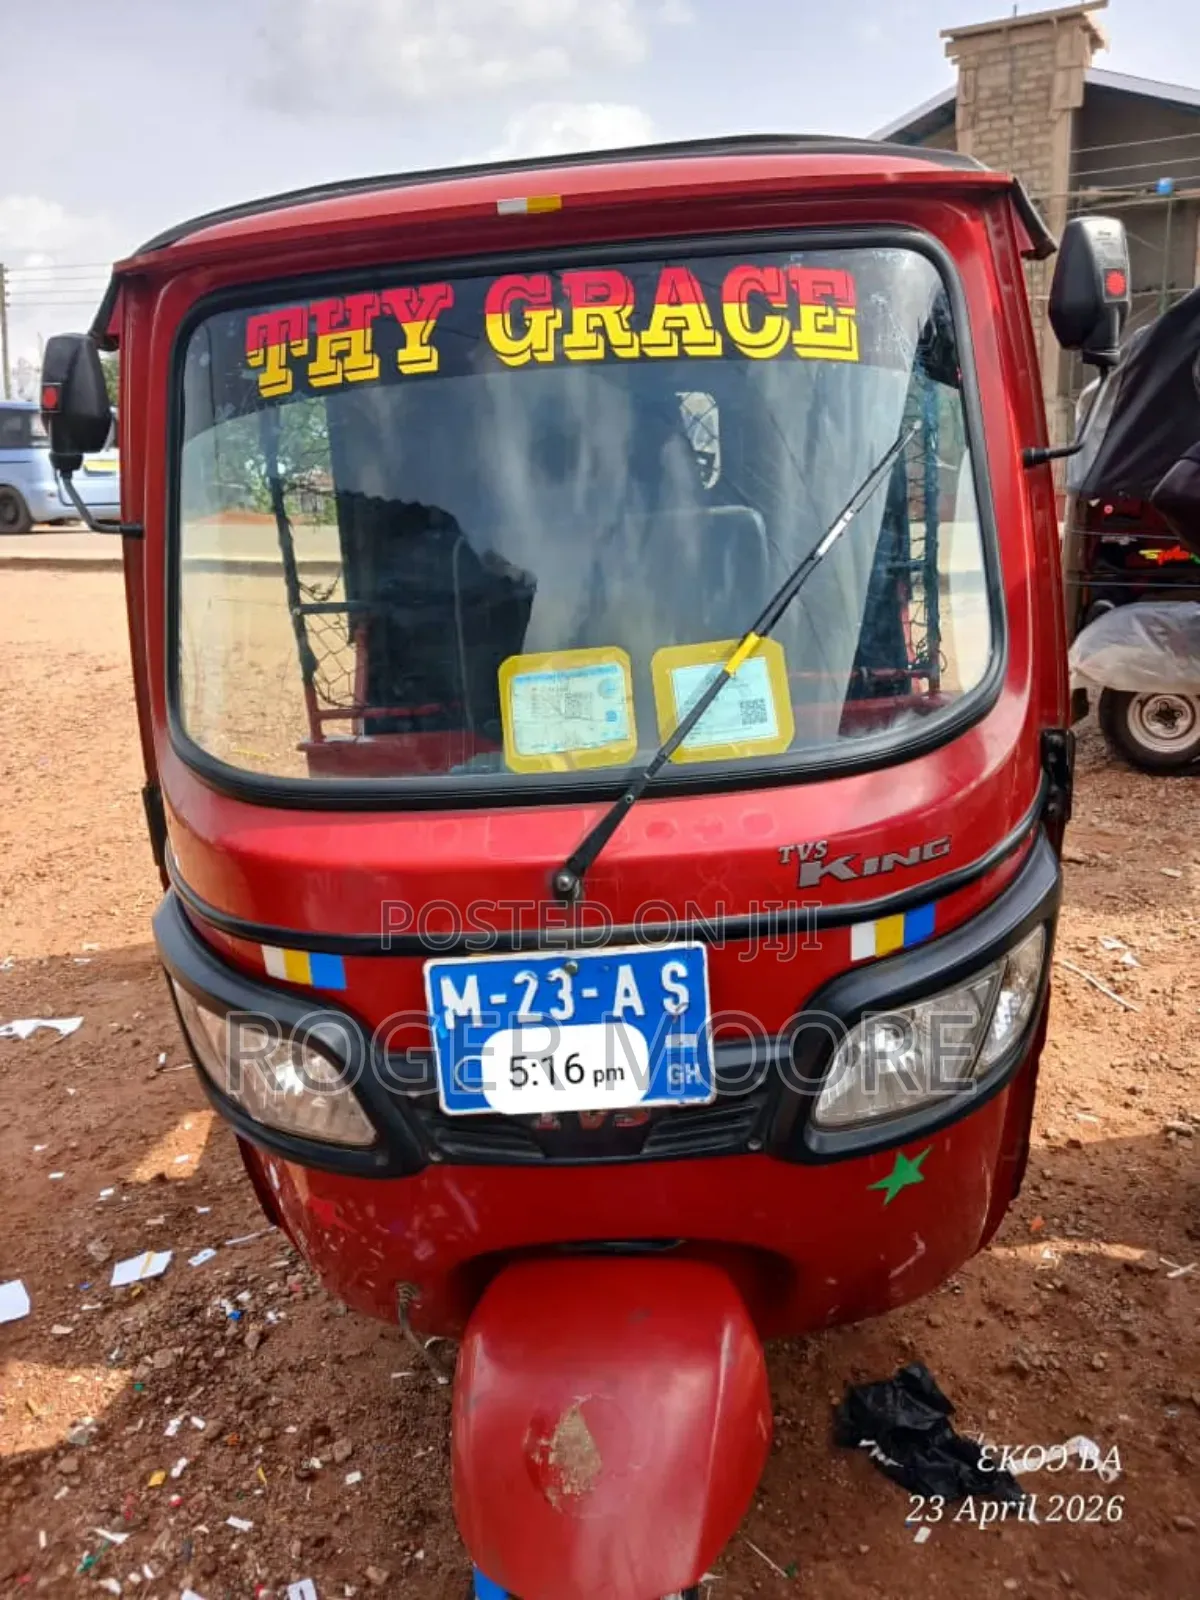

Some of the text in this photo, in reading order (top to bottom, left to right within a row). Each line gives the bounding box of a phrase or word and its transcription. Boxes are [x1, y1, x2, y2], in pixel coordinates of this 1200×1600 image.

[246, 263, 859, 398] THY GRACE
[778, 839, 828, 864] TVS
[797, 835, 952, 889] KING
[667, 1062, 701, 1085] GH
